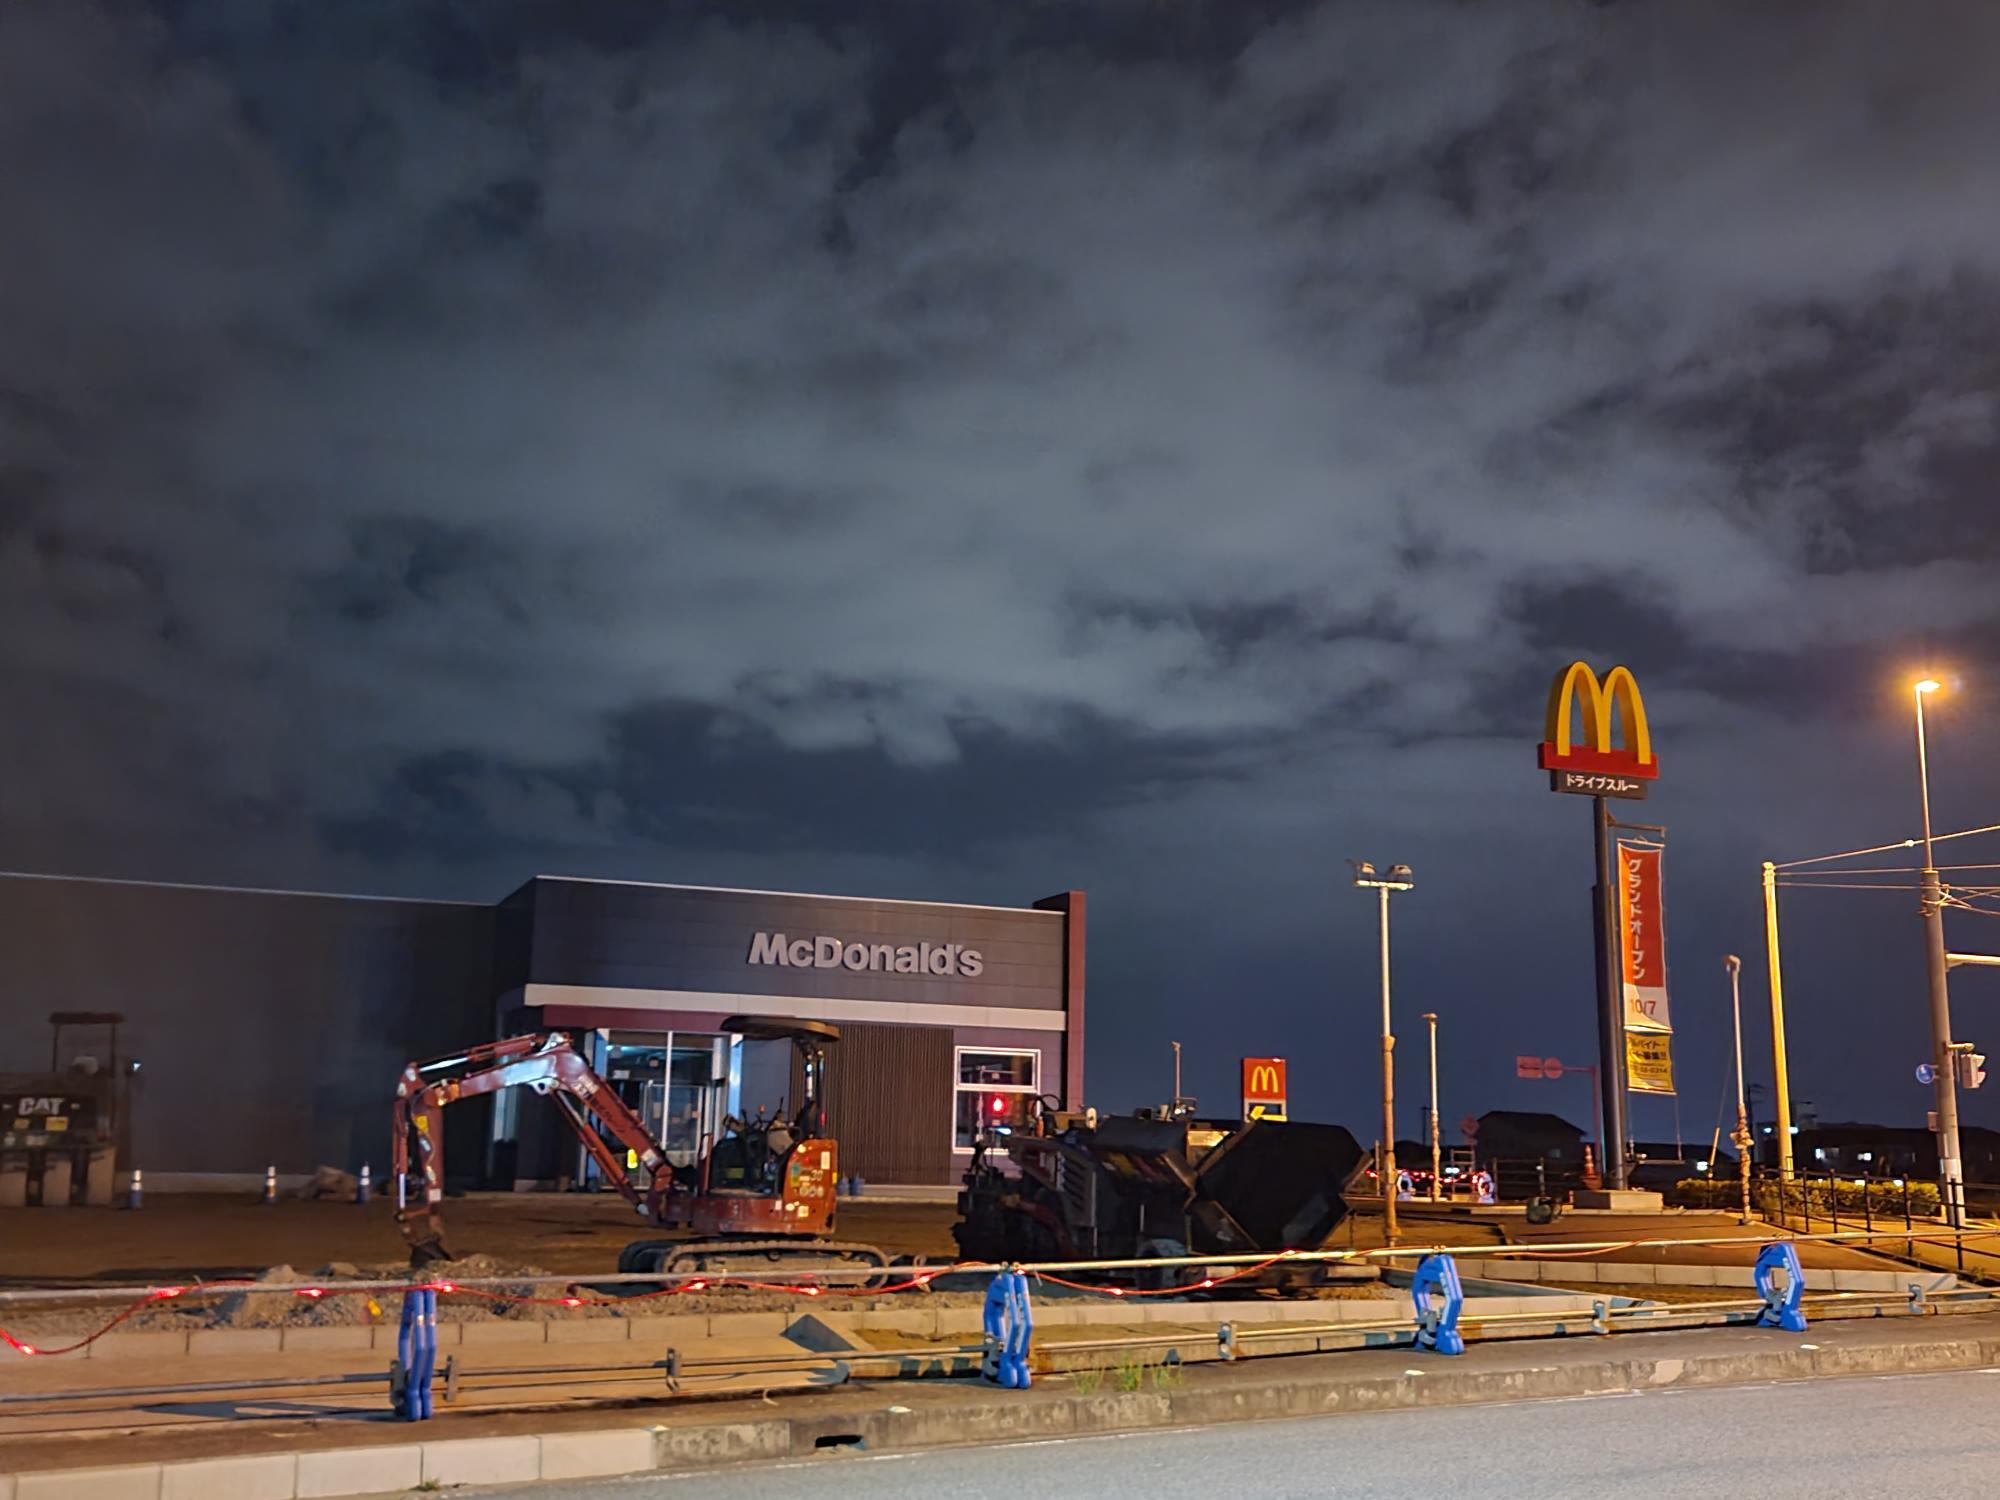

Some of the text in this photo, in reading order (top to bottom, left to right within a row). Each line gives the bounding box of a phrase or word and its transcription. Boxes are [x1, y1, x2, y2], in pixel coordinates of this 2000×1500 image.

[1565, 774, 1639, 792] ドライブスルー
[1628, 858, 1646, 980] グランドオープン
[748, 932, 984, 977] McDonald's
[1630, 998, 1657, 1015] 10/7
[18, 1097, 65, 1115] CAT
